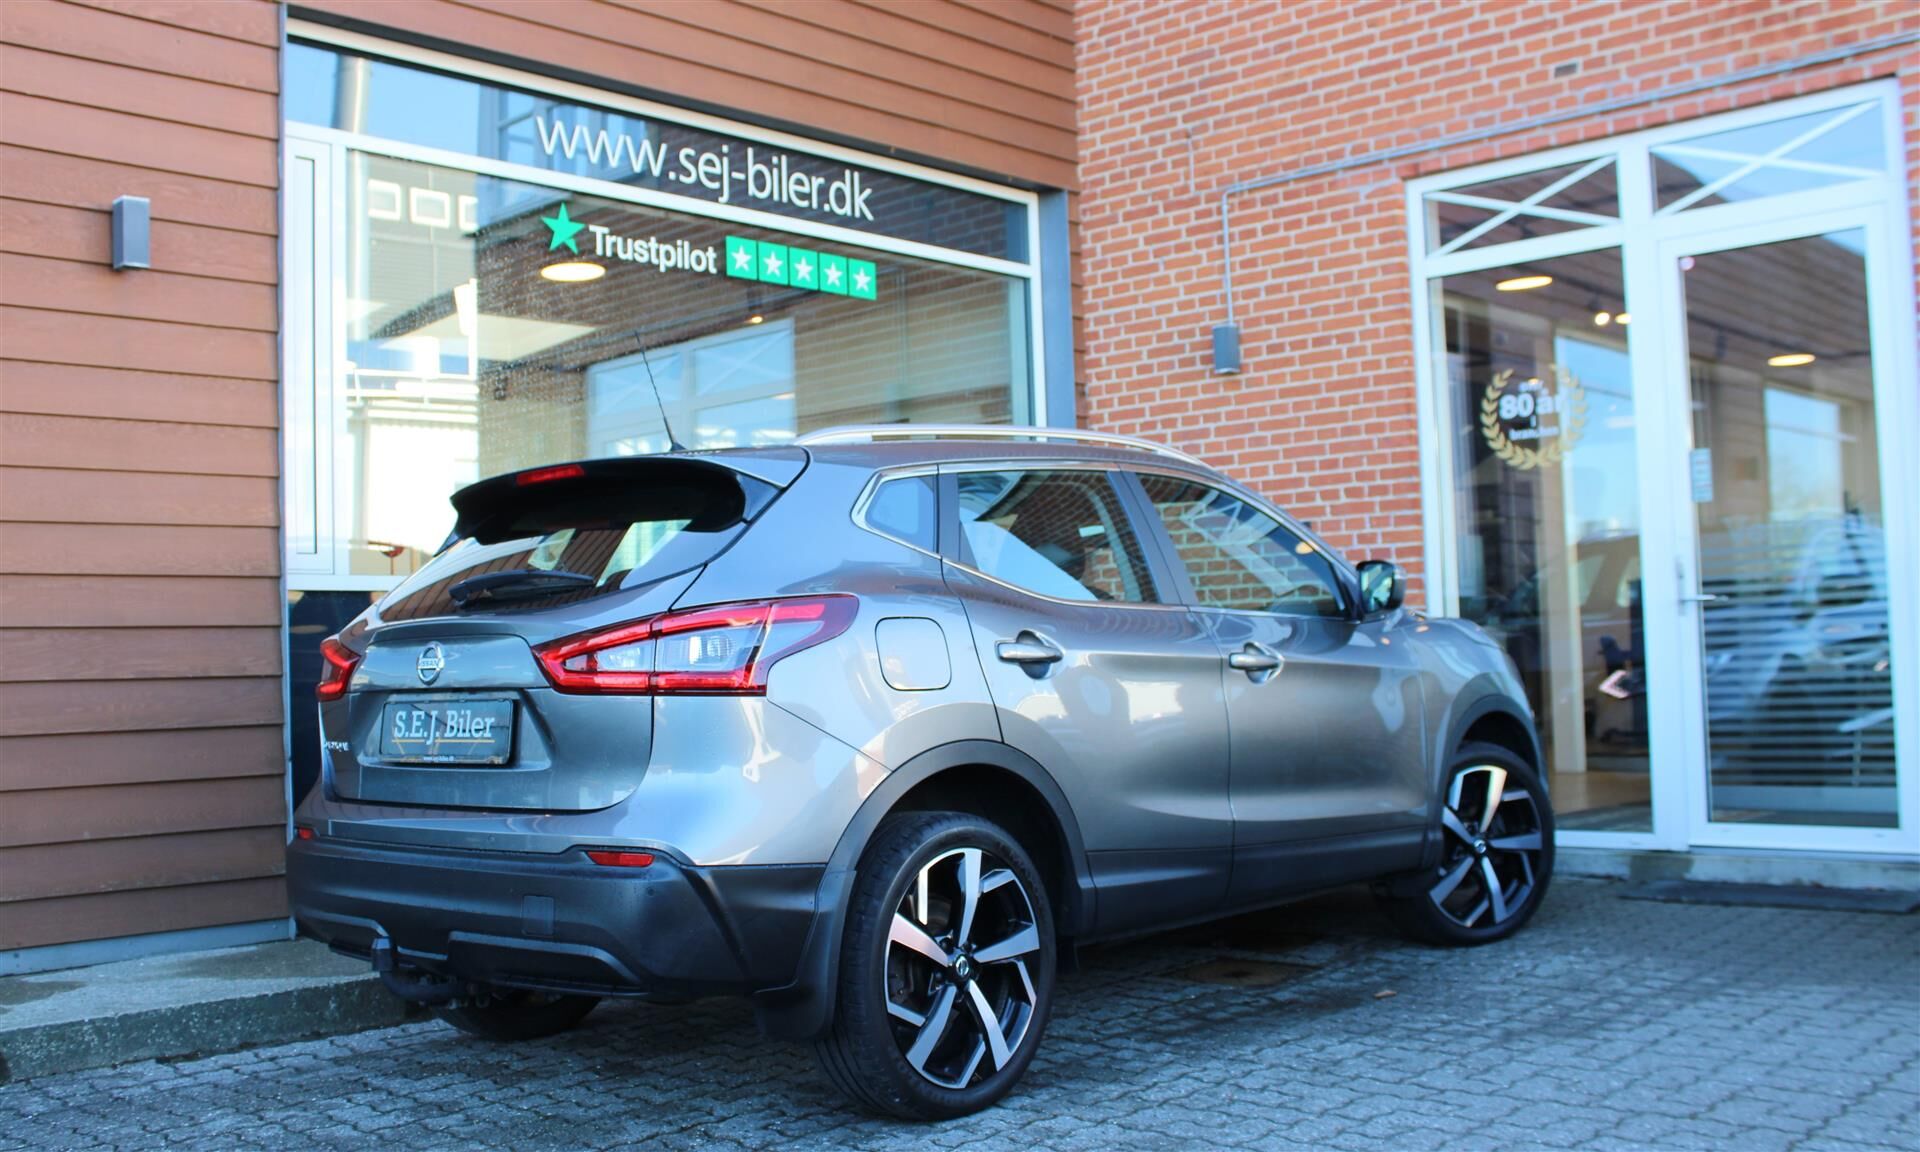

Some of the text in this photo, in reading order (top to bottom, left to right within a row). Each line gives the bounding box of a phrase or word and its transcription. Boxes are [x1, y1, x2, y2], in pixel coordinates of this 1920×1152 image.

[537, 116, 874, 221] www.sej-biler.dk
[588, 224, 717, 273] Trustpilot
[1499, 393, 1534, 419] 80
[394, 709, 495, 745] S.E.J. Biler
